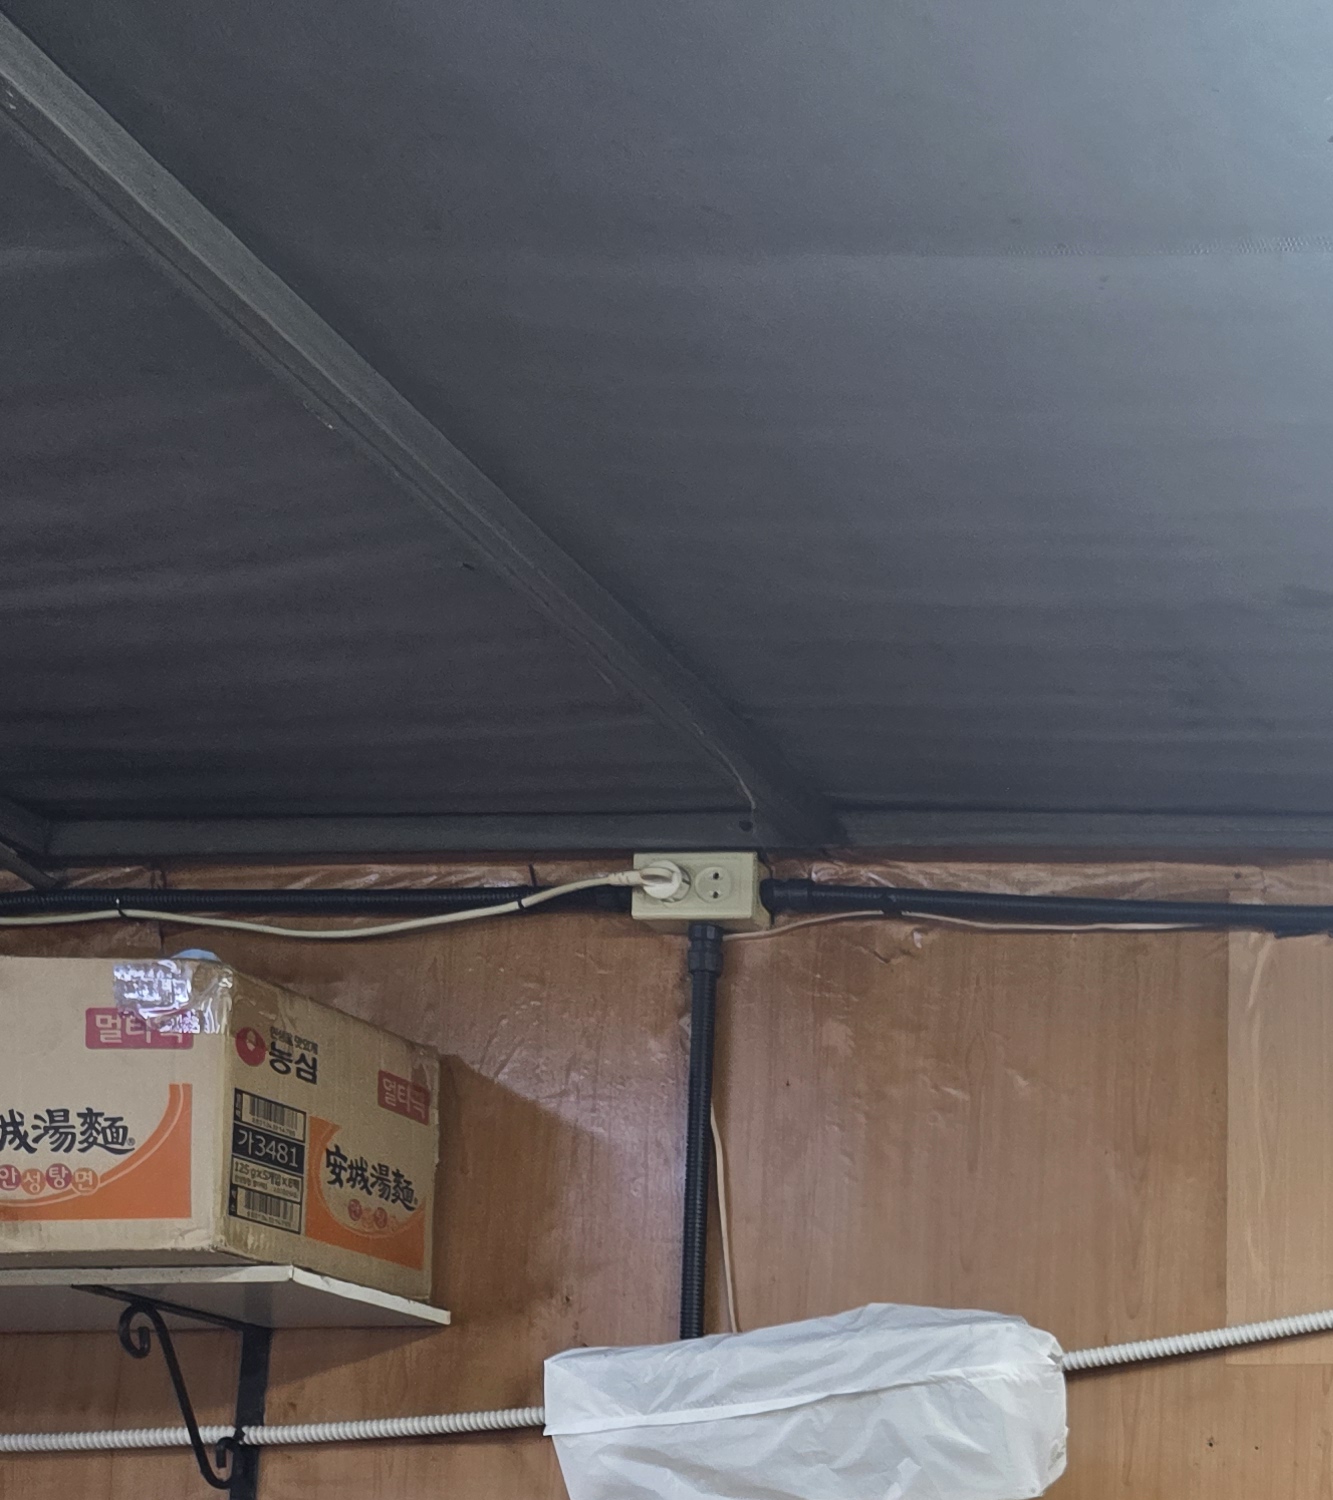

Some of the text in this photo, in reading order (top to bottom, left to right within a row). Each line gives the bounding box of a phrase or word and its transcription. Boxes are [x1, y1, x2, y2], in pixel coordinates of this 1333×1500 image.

[268, 1041, 318, 1085] 농심
[238, 1130, 298, 1168] 가3481
[0, 1166, 94, 1193] 안성탕면
